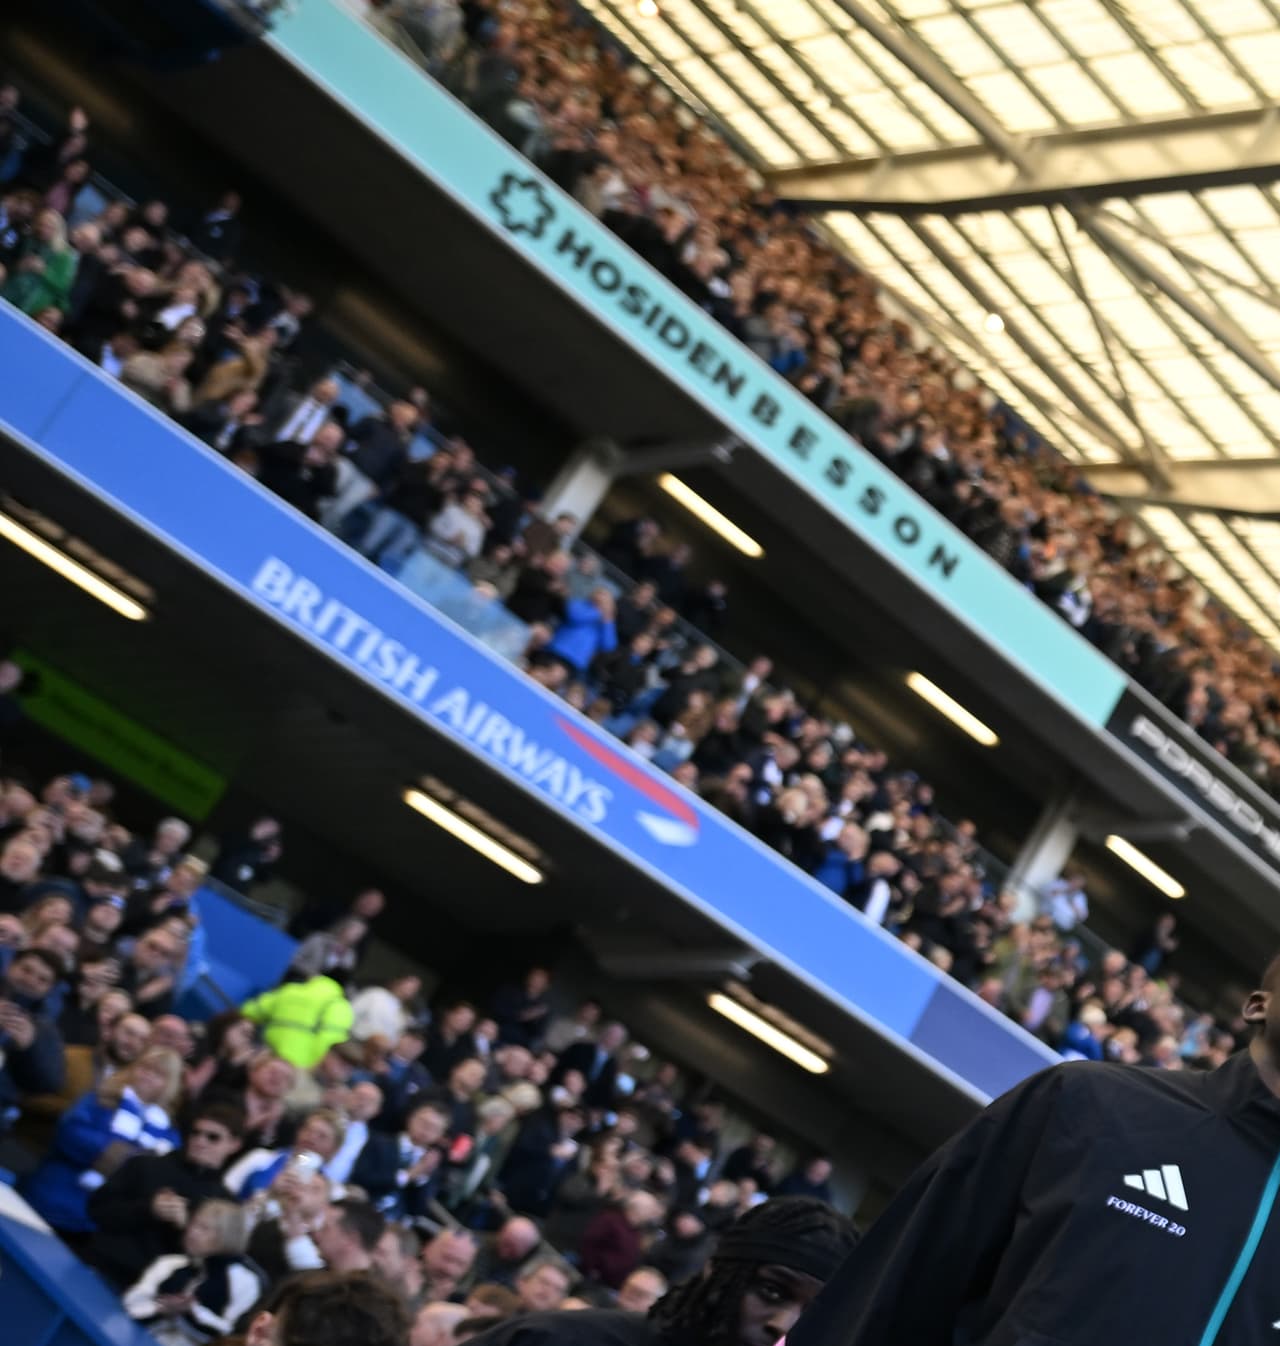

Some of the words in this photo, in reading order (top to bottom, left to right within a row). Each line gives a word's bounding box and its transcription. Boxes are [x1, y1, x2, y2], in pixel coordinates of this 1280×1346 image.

[556, 230, 748, 399] HOSIDEN
[750, 393, 961, 582] BESSON
[251, 556, 440, 701] BRITISH
[432, 688, 615, 824] AIRWAYS
[1106, 1195, 1169, 1230] FOREVER
[1168, 1223, 1187, 1238] 20
